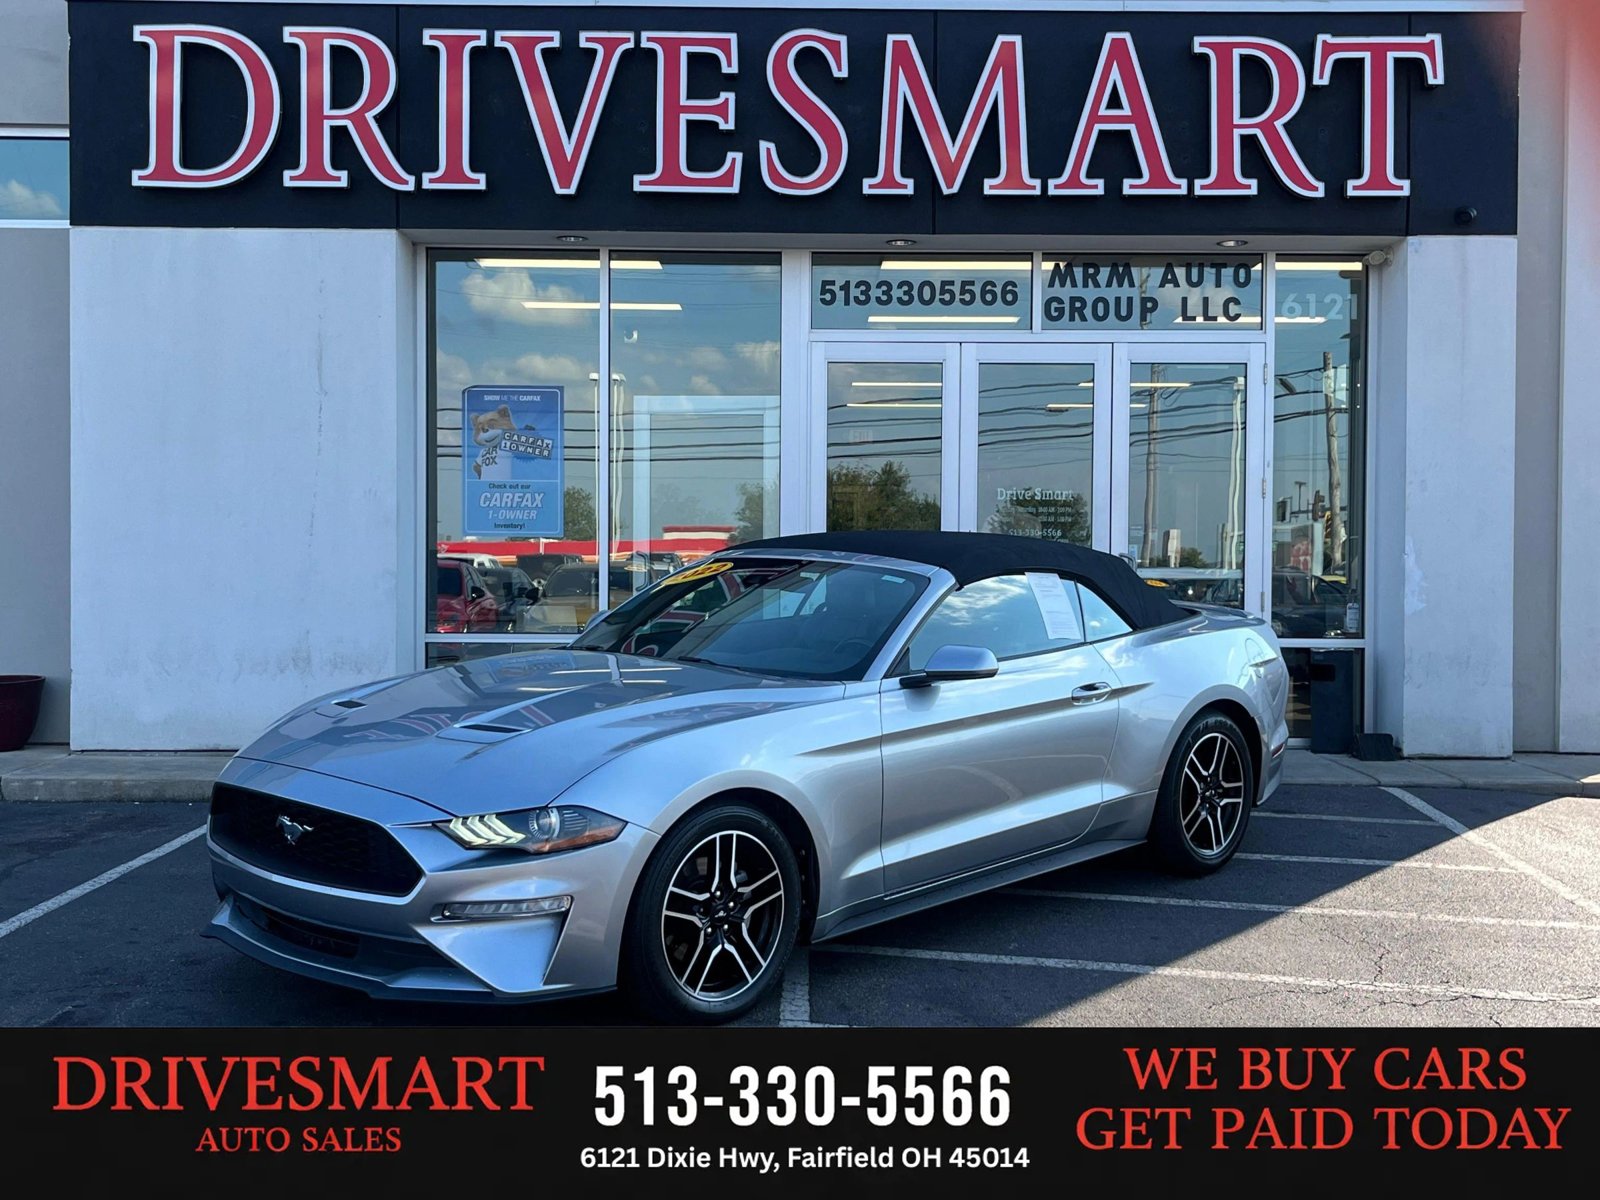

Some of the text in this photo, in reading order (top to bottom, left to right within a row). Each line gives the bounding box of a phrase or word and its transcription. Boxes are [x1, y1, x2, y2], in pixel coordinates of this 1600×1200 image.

[131, 24, 1445, 198] DRIVESMART
[1047, 262, 1252, 288] MRM AUTO
[819, 279, 1019, 306] 5133305566
[1044, 296, 1242, 322] GROUP LLC
[1281, 293, 1358, 320] 6121
[504, 432, 552, 449] CARFAX
[481, 447, 498, 457] CAR
[482, 456, 498, 467] FOX
[480, 492, 544, 508] CARFAX
[997, 487, 1074, 500] Drive Smart
[488, 509, 538, 520] 1-OWNER
[494, 522, 526, 530] Inventory!
[1009, 528, 1062, 537] 513-330-5566
